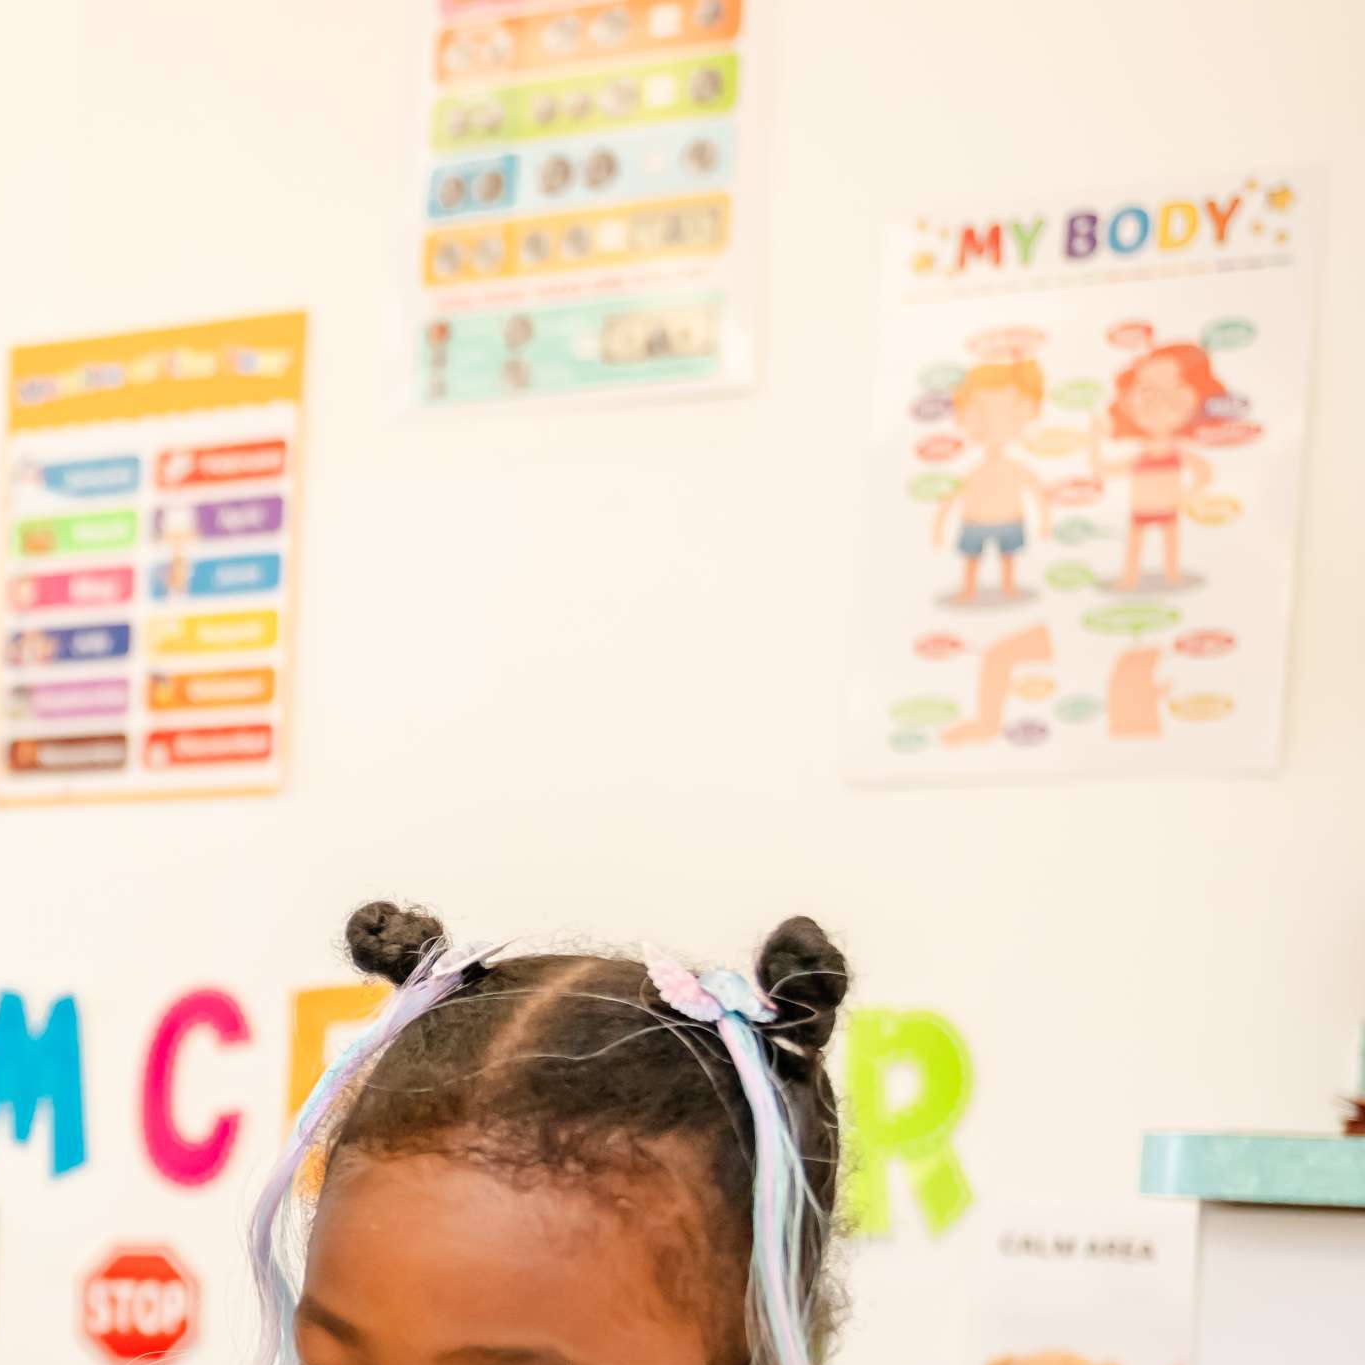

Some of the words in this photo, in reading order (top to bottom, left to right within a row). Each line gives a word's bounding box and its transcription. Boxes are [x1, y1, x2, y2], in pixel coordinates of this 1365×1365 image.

[957, 217, 1044, 270] MY
[1064, 195, 1244, 260] BODY
[998, 1231, 1077, 1258] CALM
[1082, 1234, 1155, 1261] AREA
[88, 1278, 189, 1337] STOP
